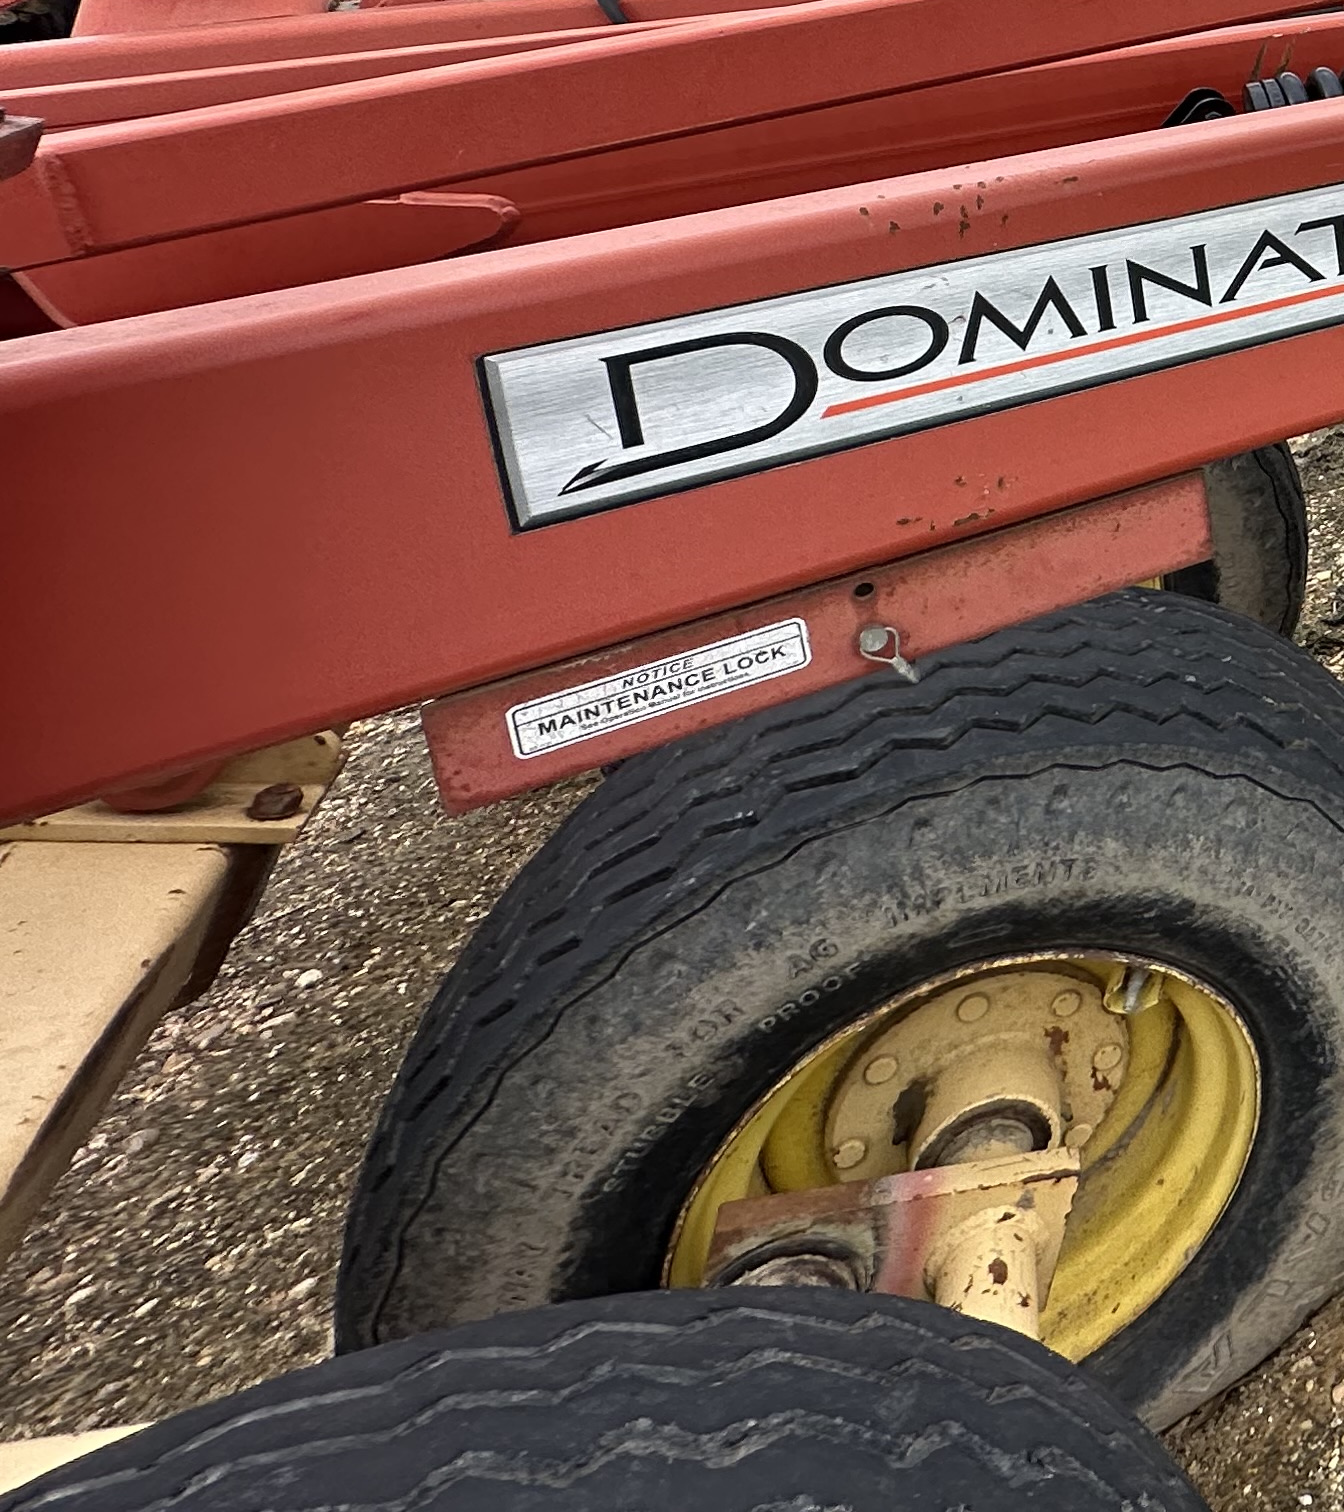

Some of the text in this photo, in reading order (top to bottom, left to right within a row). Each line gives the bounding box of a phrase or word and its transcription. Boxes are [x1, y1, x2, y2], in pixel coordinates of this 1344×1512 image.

[537, 644, 787, 737] MAINTENANCE LOCK
[621, 657, 694, 689] NOTICE
[580, 719, 600, 732] See
[758, 962, 862, 1033] PROOF
